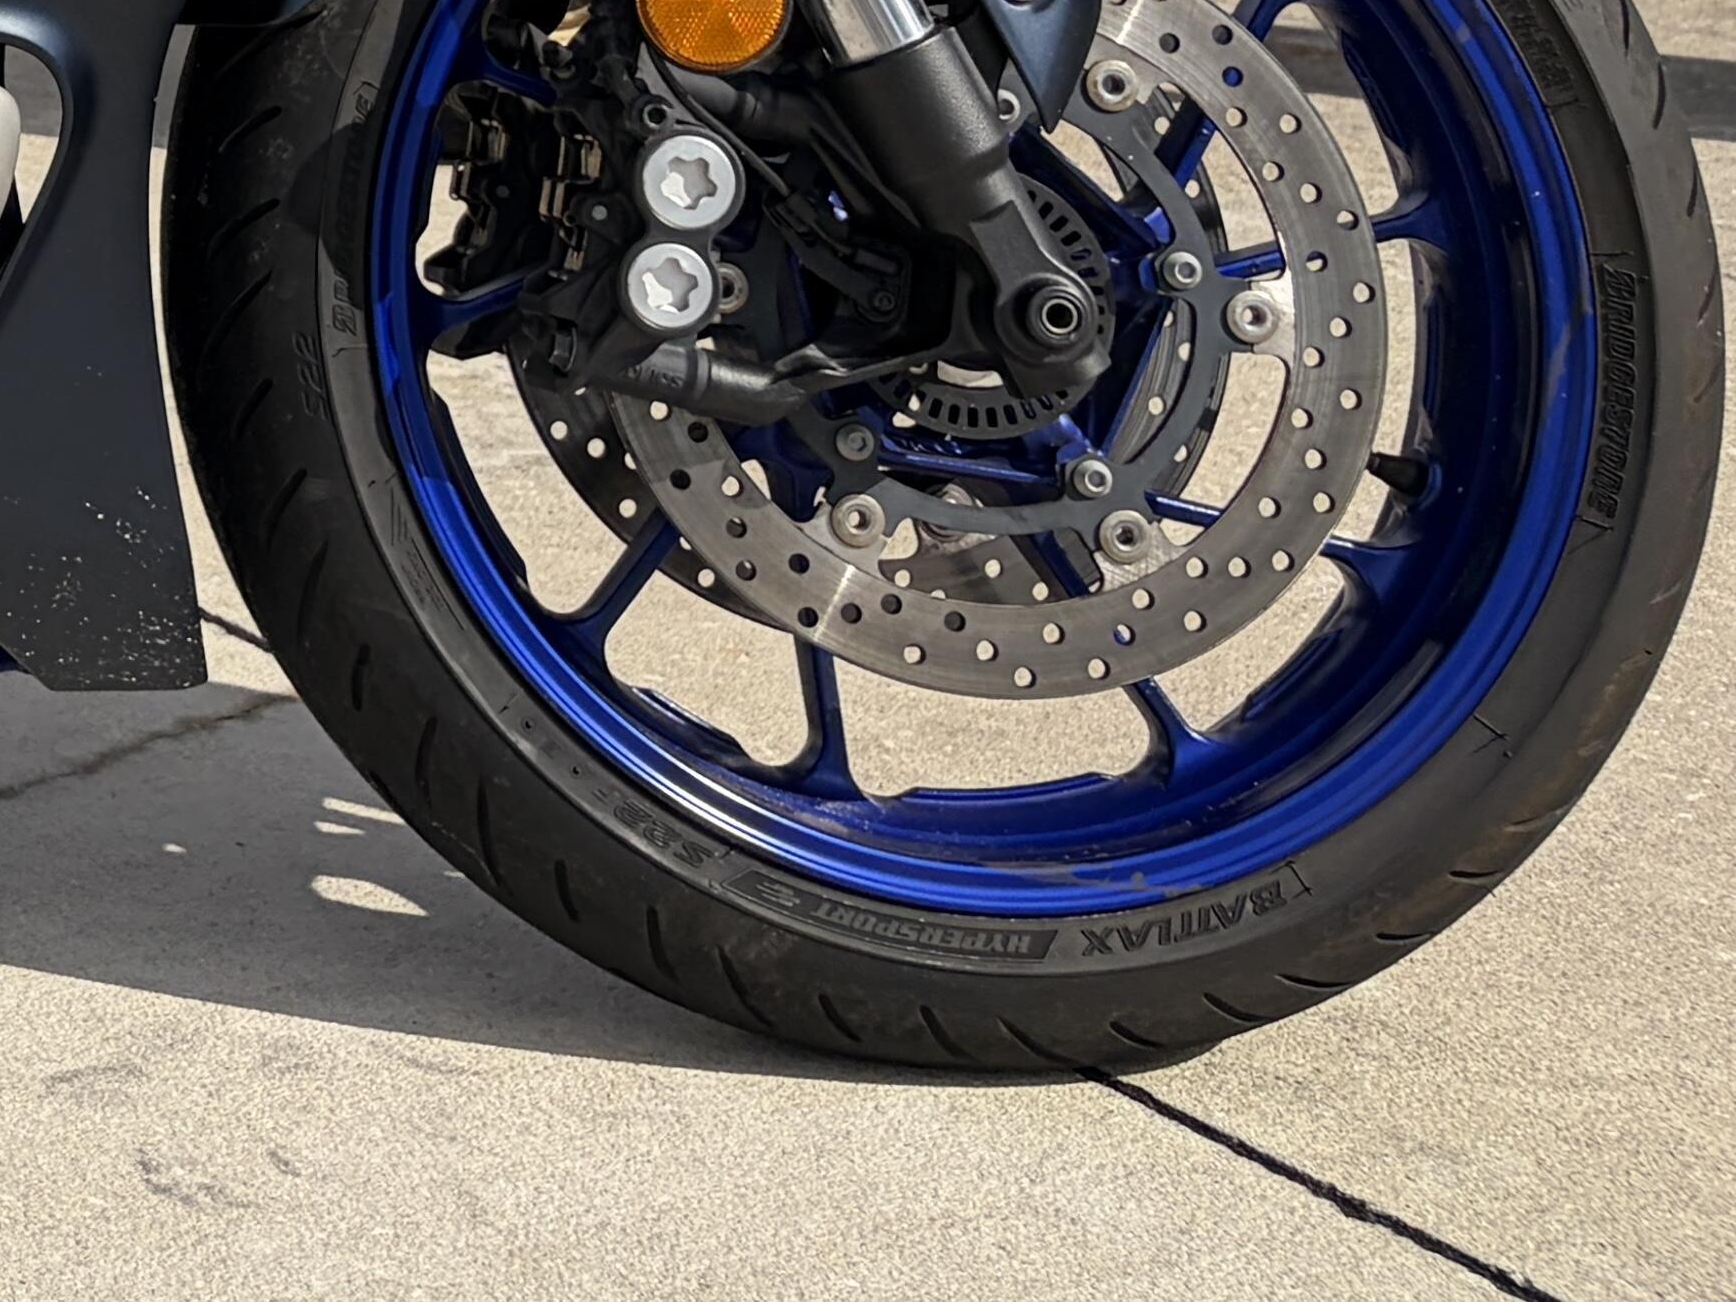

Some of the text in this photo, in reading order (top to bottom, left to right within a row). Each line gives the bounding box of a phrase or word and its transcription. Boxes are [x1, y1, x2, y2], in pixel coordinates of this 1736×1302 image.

[1595, 264, 1639, 518] BRIDGESTONE
[808, 896, 1033, 956] HYPERSPORT
[1079, 876, 1289, 957] BATTLAX
